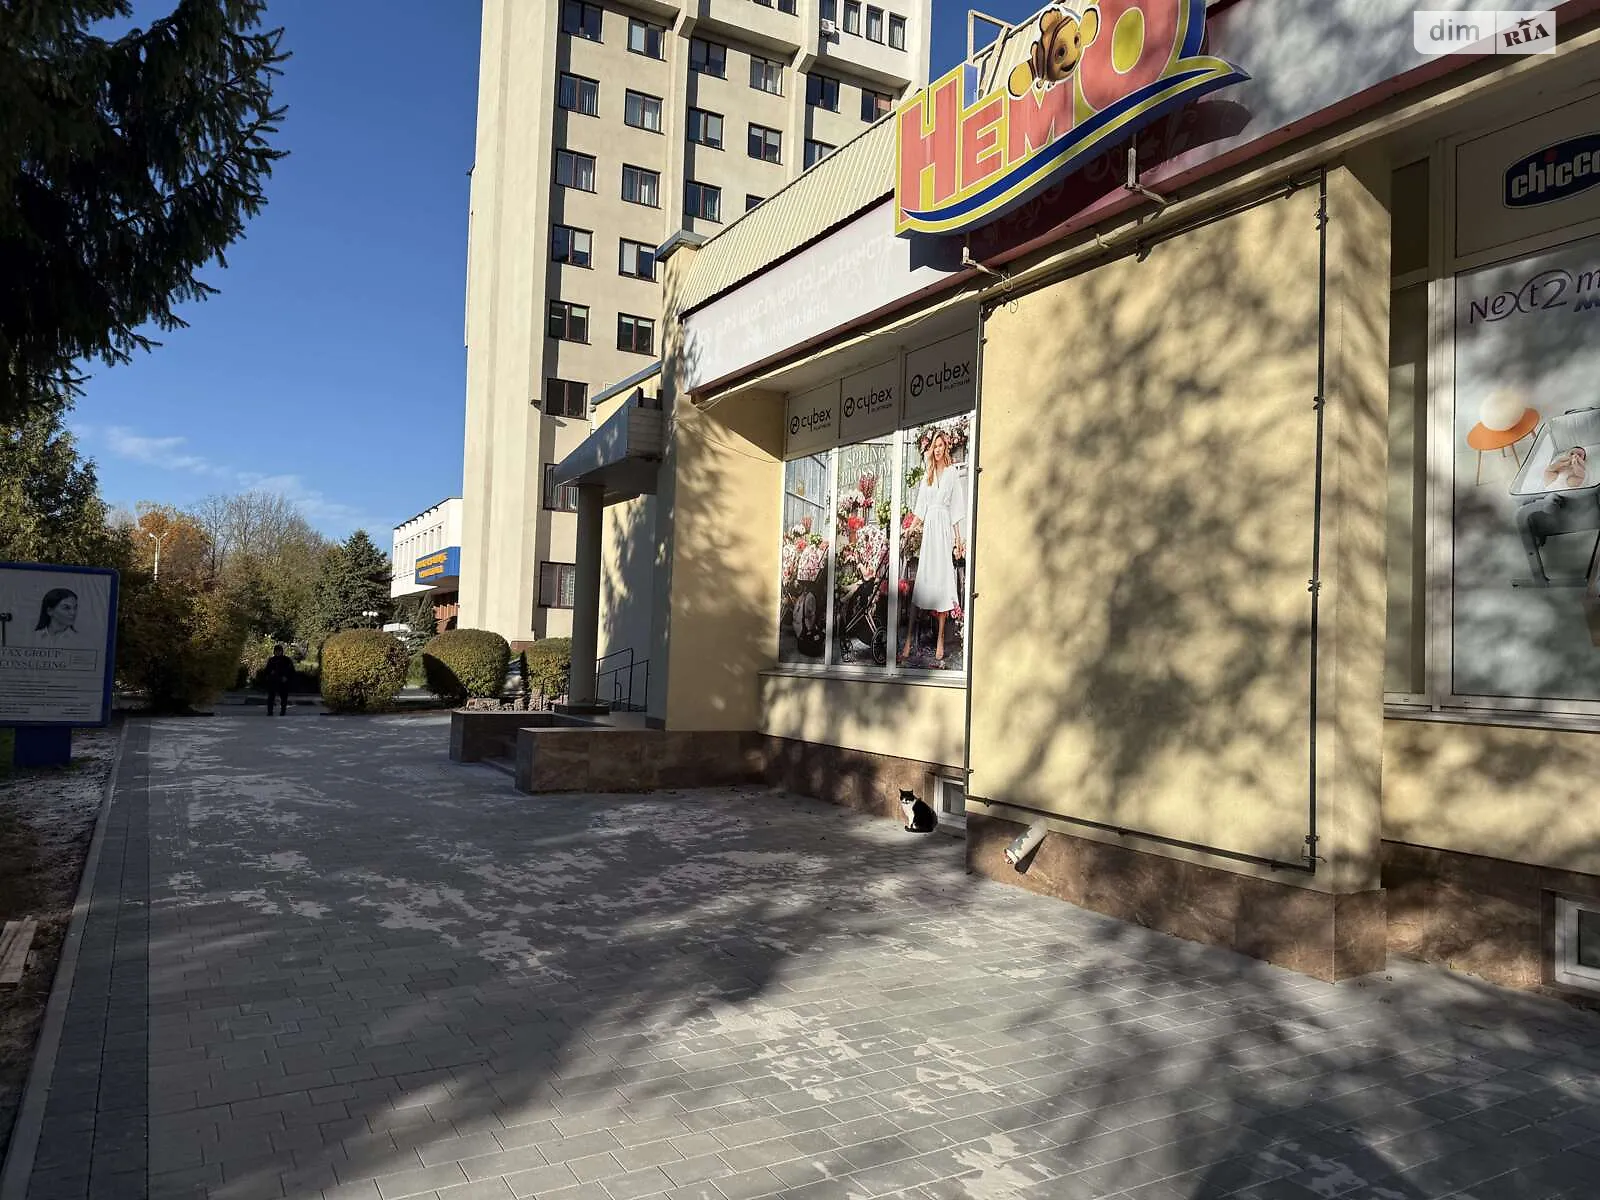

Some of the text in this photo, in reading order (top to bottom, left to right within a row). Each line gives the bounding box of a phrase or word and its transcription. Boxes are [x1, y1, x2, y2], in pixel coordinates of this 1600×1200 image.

[926, 361, 970, 392] cybex
[856, 386, 893, 415] cybex
[801, 407, 832, 432] cybex
